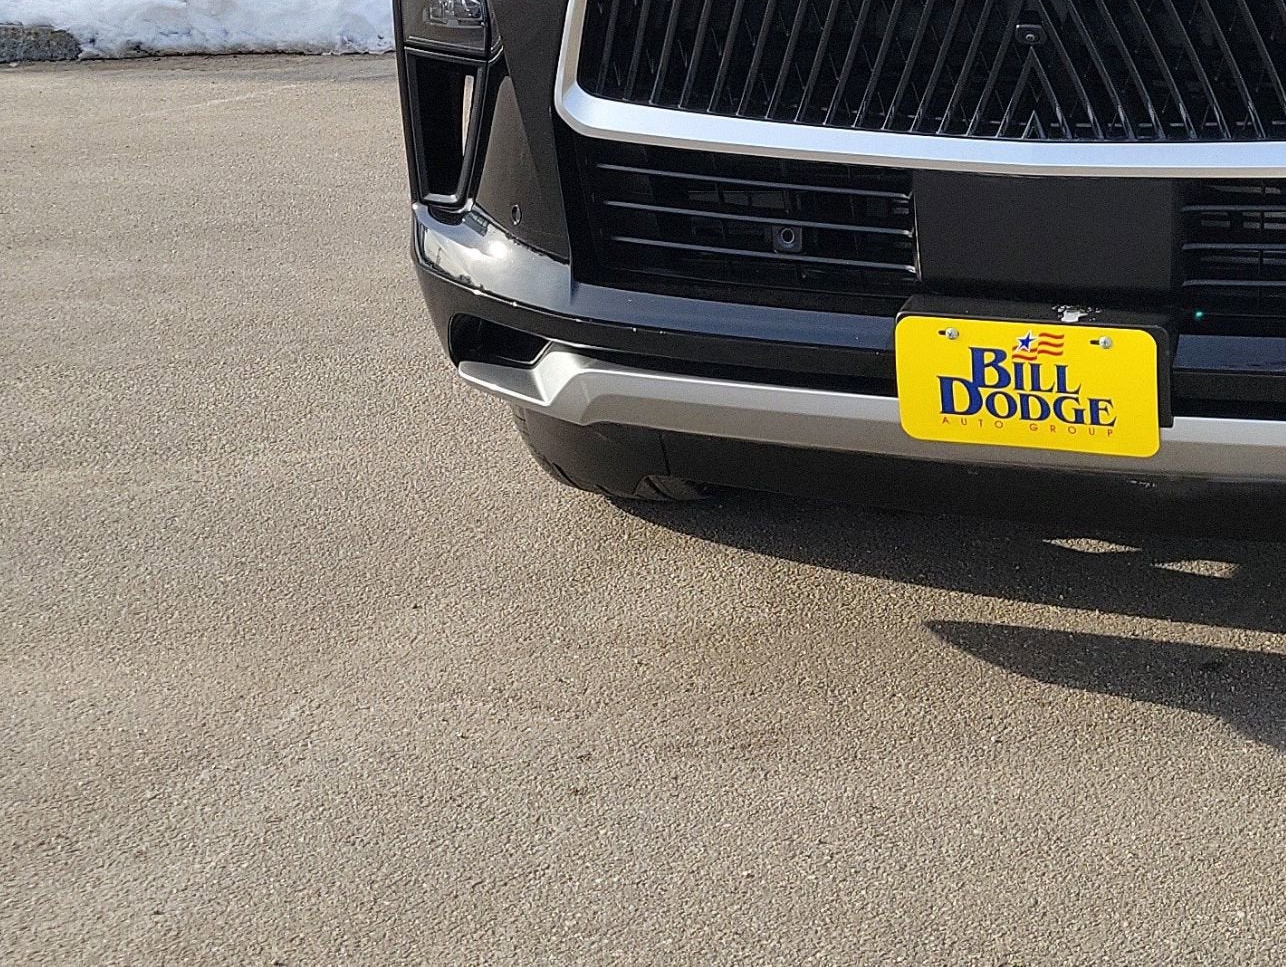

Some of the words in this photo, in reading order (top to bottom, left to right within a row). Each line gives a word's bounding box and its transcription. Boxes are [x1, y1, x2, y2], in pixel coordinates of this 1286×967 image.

[968, 346, 1082, 395] BILL
[936, 375, 1117, 427] DODGE
[942, 416, 1004, 429] AUTO
[1029, 423, 1114, 437] GROUP
